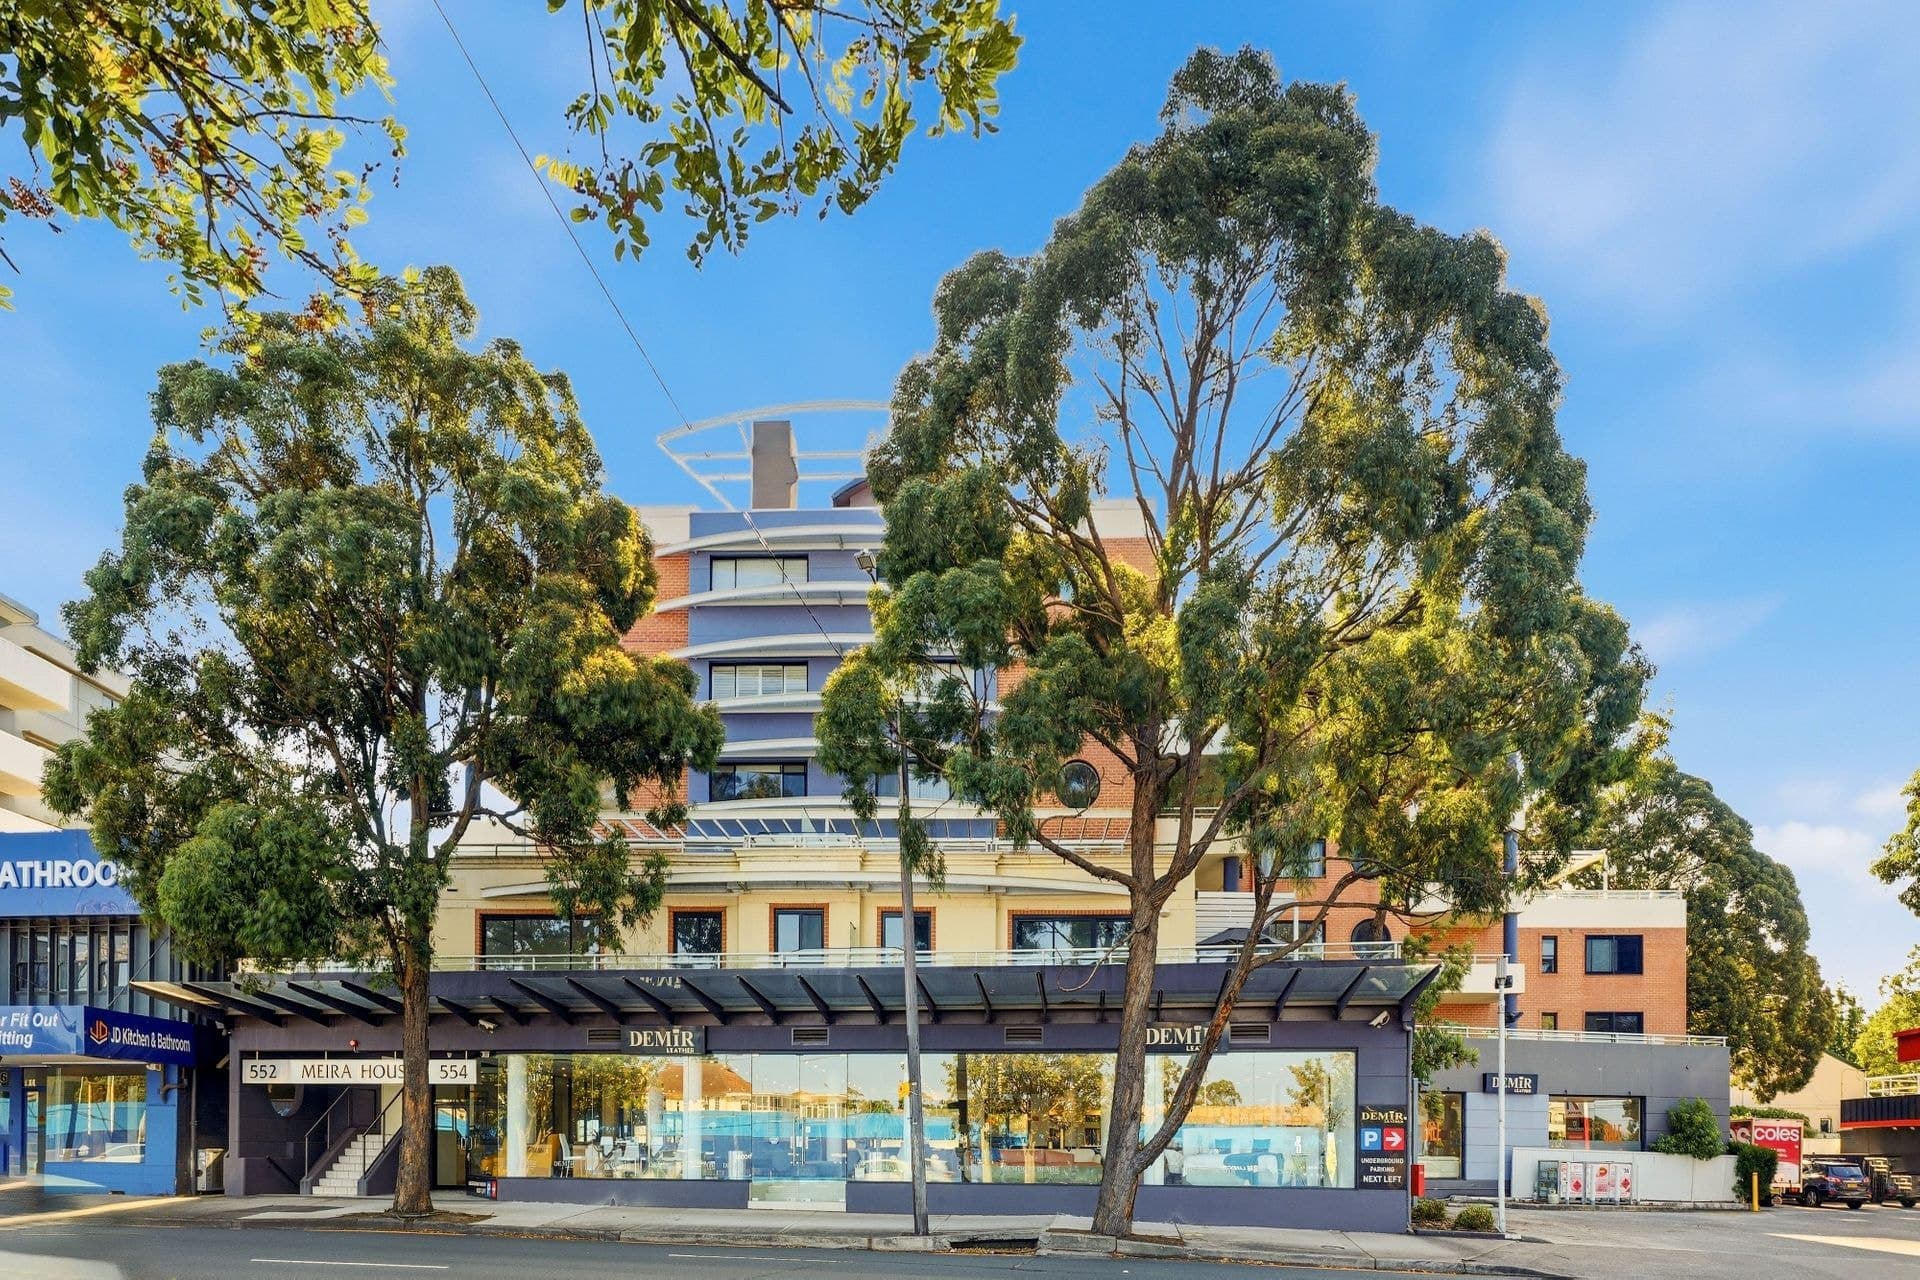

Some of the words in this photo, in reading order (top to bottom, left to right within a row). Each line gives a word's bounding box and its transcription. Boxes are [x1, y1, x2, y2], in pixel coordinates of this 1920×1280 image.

[0, 859, 120, 888] ATHROO
[10, 1011, 30, 1027] Fit
[32, 1012, 59, 1028] Out
[110, 1026, 121, 1044] JD
[122, 1027, 150, 1048] Kitchen
[150, 1032, 157, 1048] &
[157, 1033, 191, 1052] Bathroom
[249, 1064, 277, 1079] 552
[301, 1064, 352, 1079] MEIRA
[360, 1064, 405, 1079] HOUS
[439, 1064, 468, 1079] 554
[1364, 1131, 1378, 1147] P
[1754, 1127, 1800, 1142] coles
[1362, 1175, 1383, 1183] NEXT
[1383, 1175, 1402, 1183] LEFT
